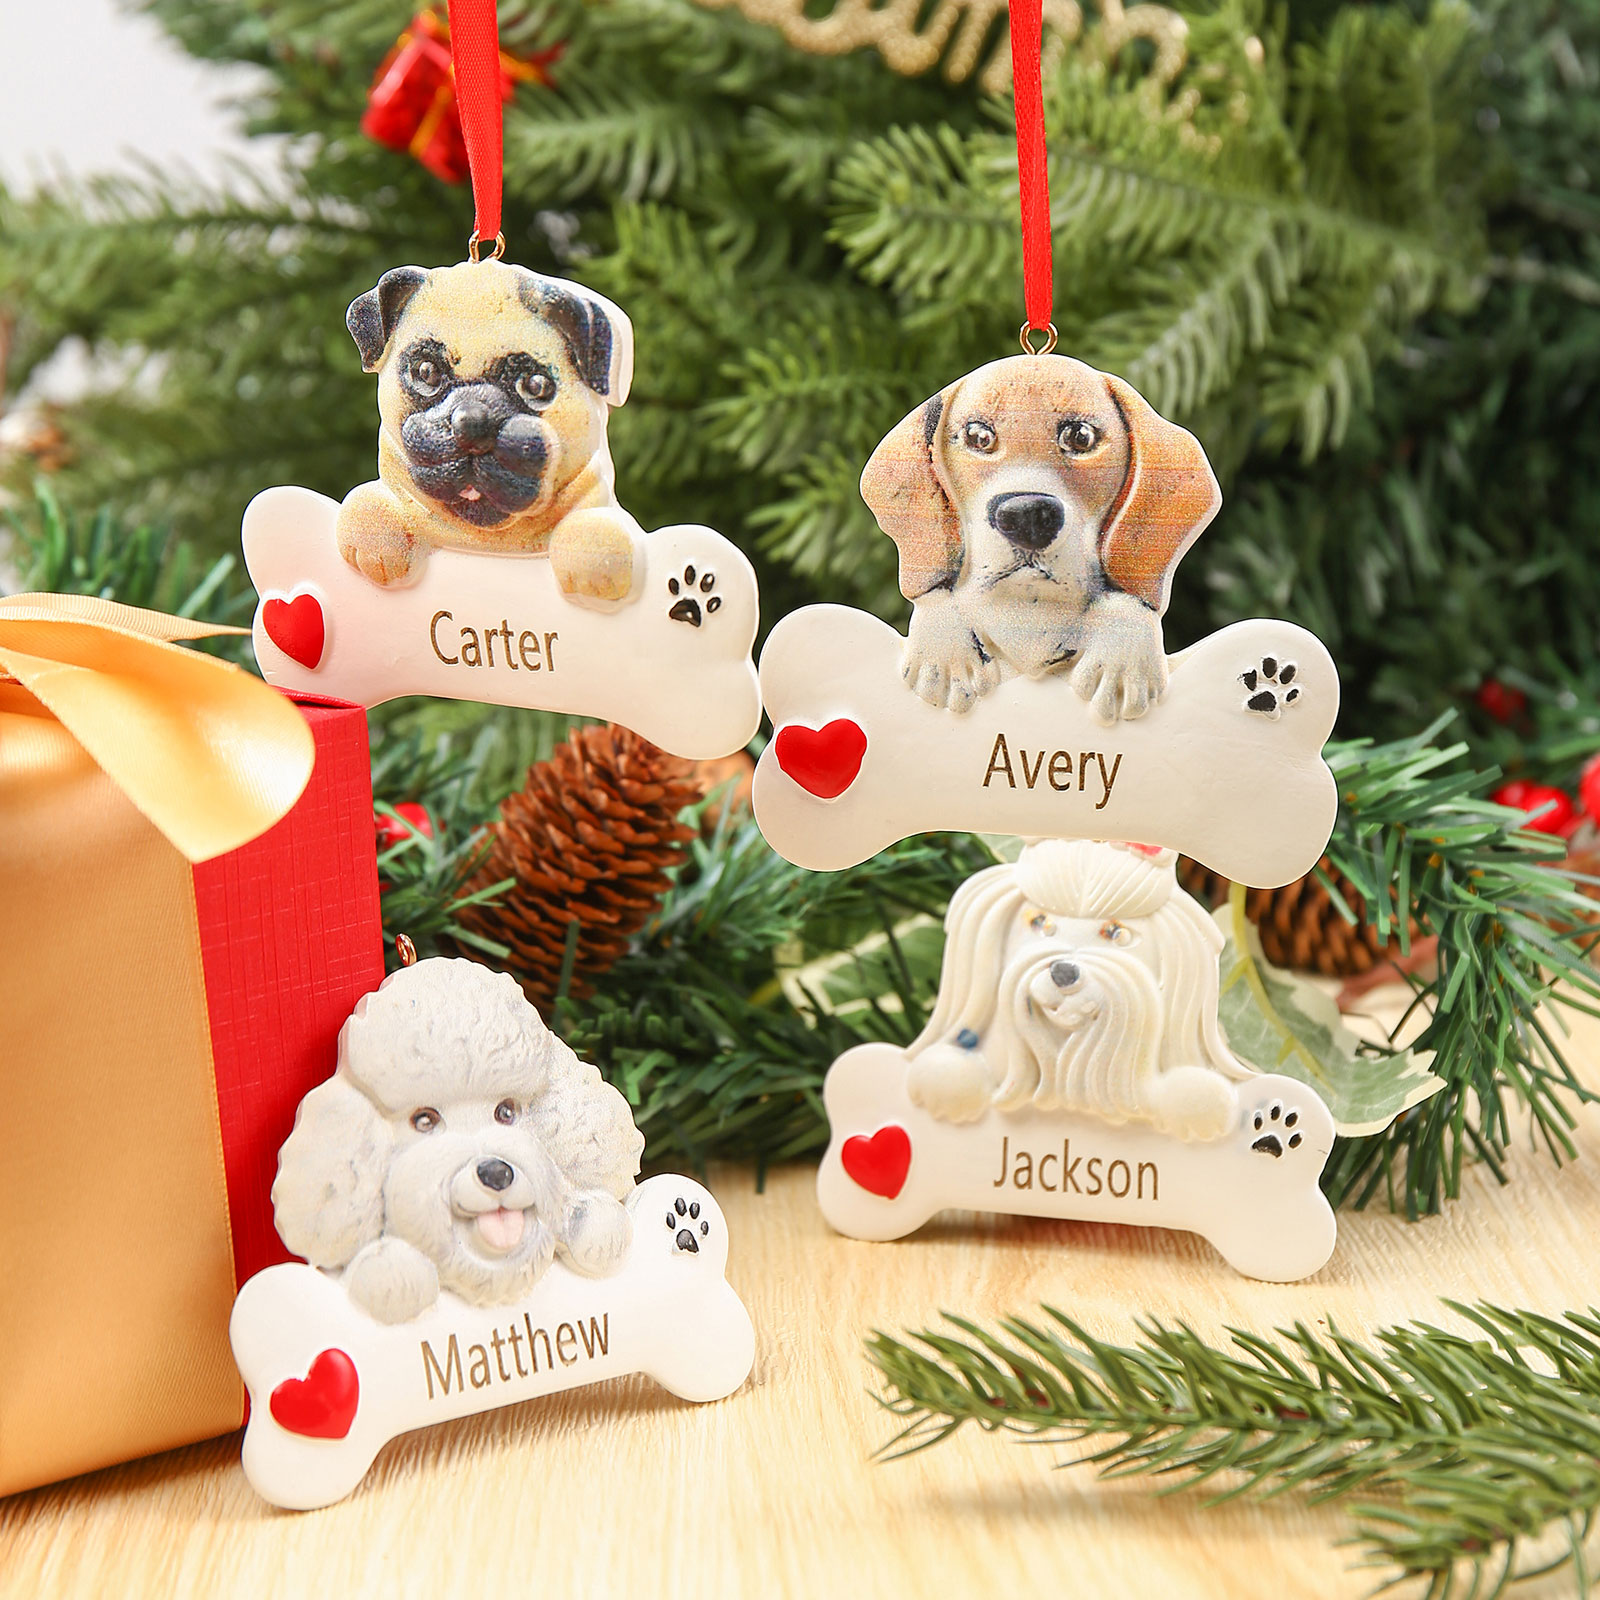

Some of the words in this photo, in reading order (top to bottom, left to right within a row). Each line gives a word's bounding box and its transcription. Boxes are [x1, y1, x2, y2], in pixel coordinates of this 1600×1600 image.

[429, 609, 560, 672] Carter
[981, 732, 1124, 810] Avery
[992, 1135, 1160, 1201] Jackson
[420, 1311, 609, 1400] Matthew
